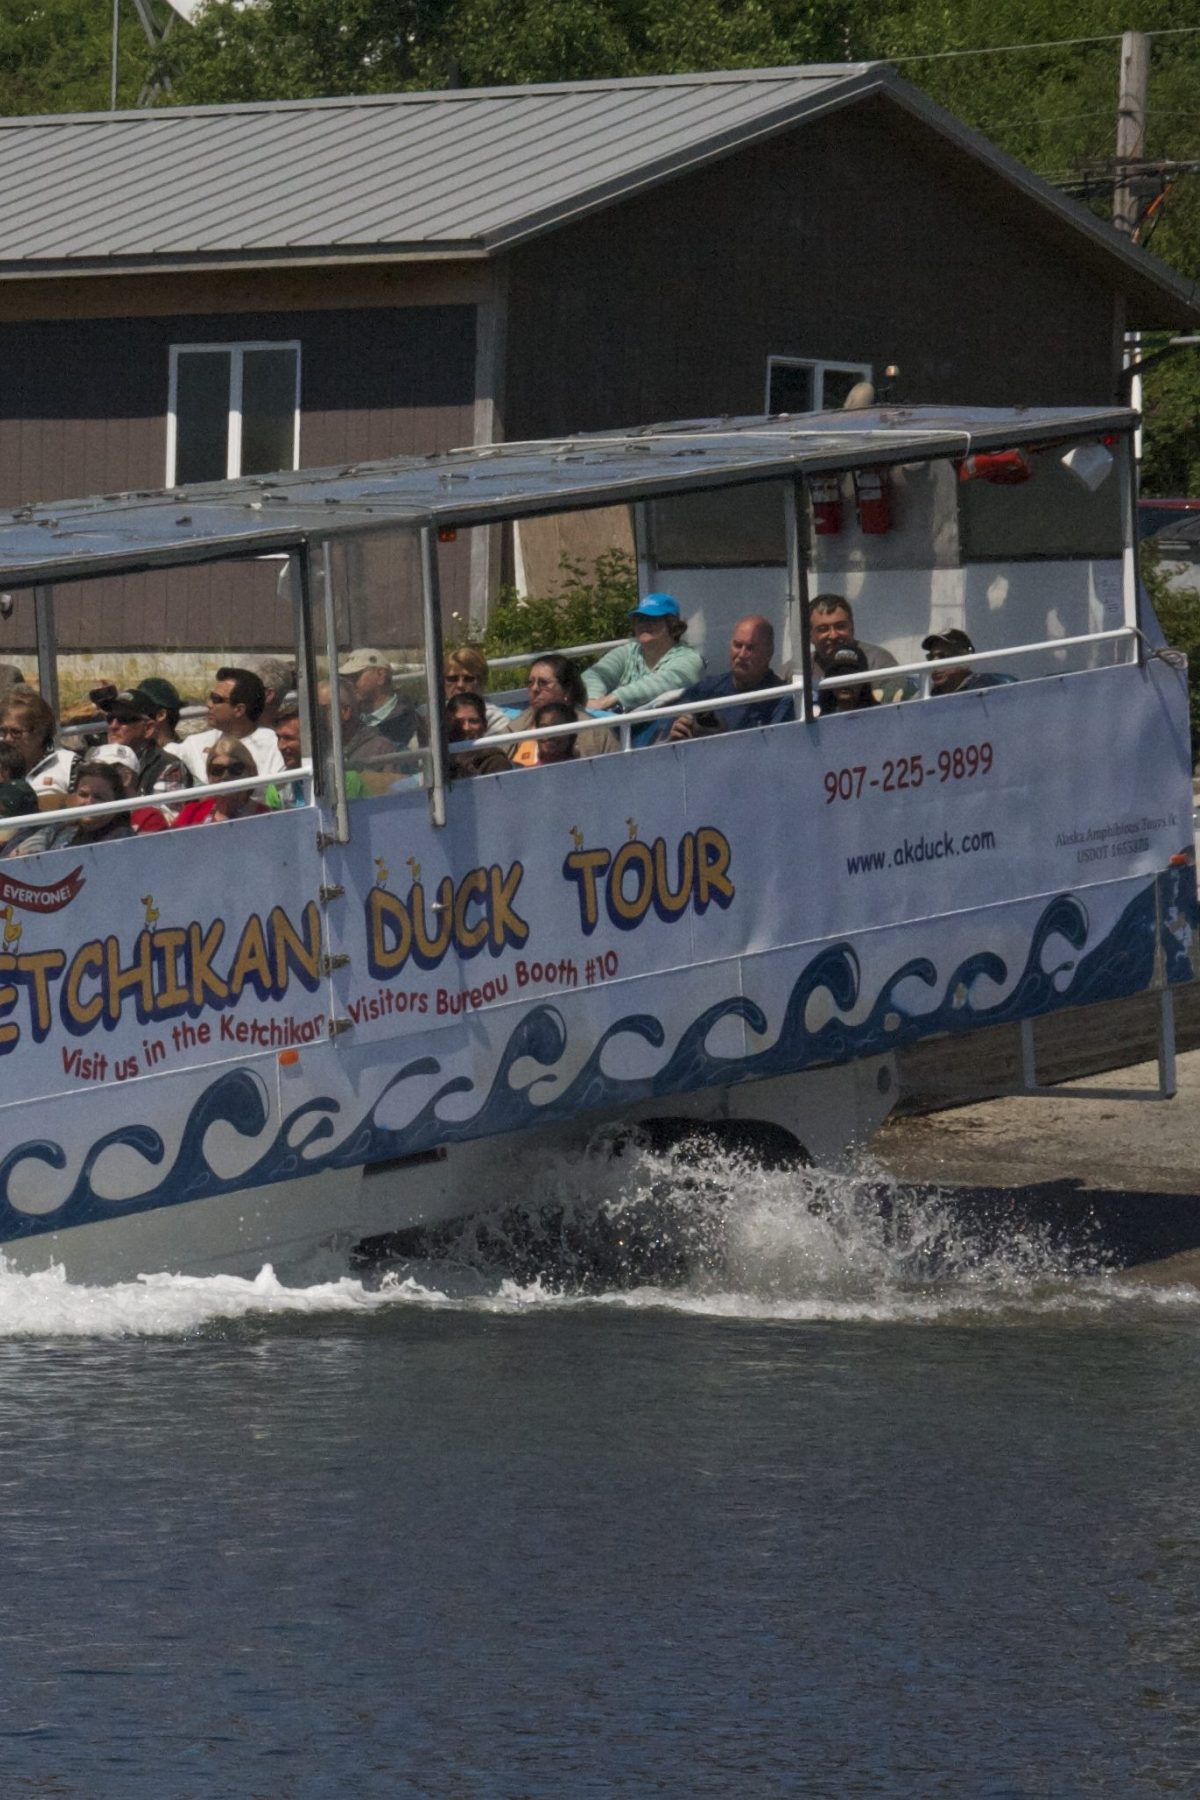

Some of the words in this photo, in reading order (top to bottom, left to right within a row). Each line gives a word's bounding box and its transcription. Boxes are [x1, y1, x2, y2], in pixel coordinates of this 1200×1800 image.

[823, 742, 994, 804] 907-225-9899
[846, 829, 995, 875] www.akduck.com
[3, 884, 71, 905] EVERYONE!
[365, 860, 529, 981] DUCK
[562, 826, 735, 936] TOUR
[61, 1046, 108, 1081] Visit
[114, 1055, 139, 1082] us
[143, 1040, 166, 1067] in
[172, 1020, 211, 1050] the
[347, 988, 429, 1025] Visitors
[435, 974, 509, 1015] Bureau
[515, 959, 578, 987] Booth
[584, 950, 619, 986] #10
